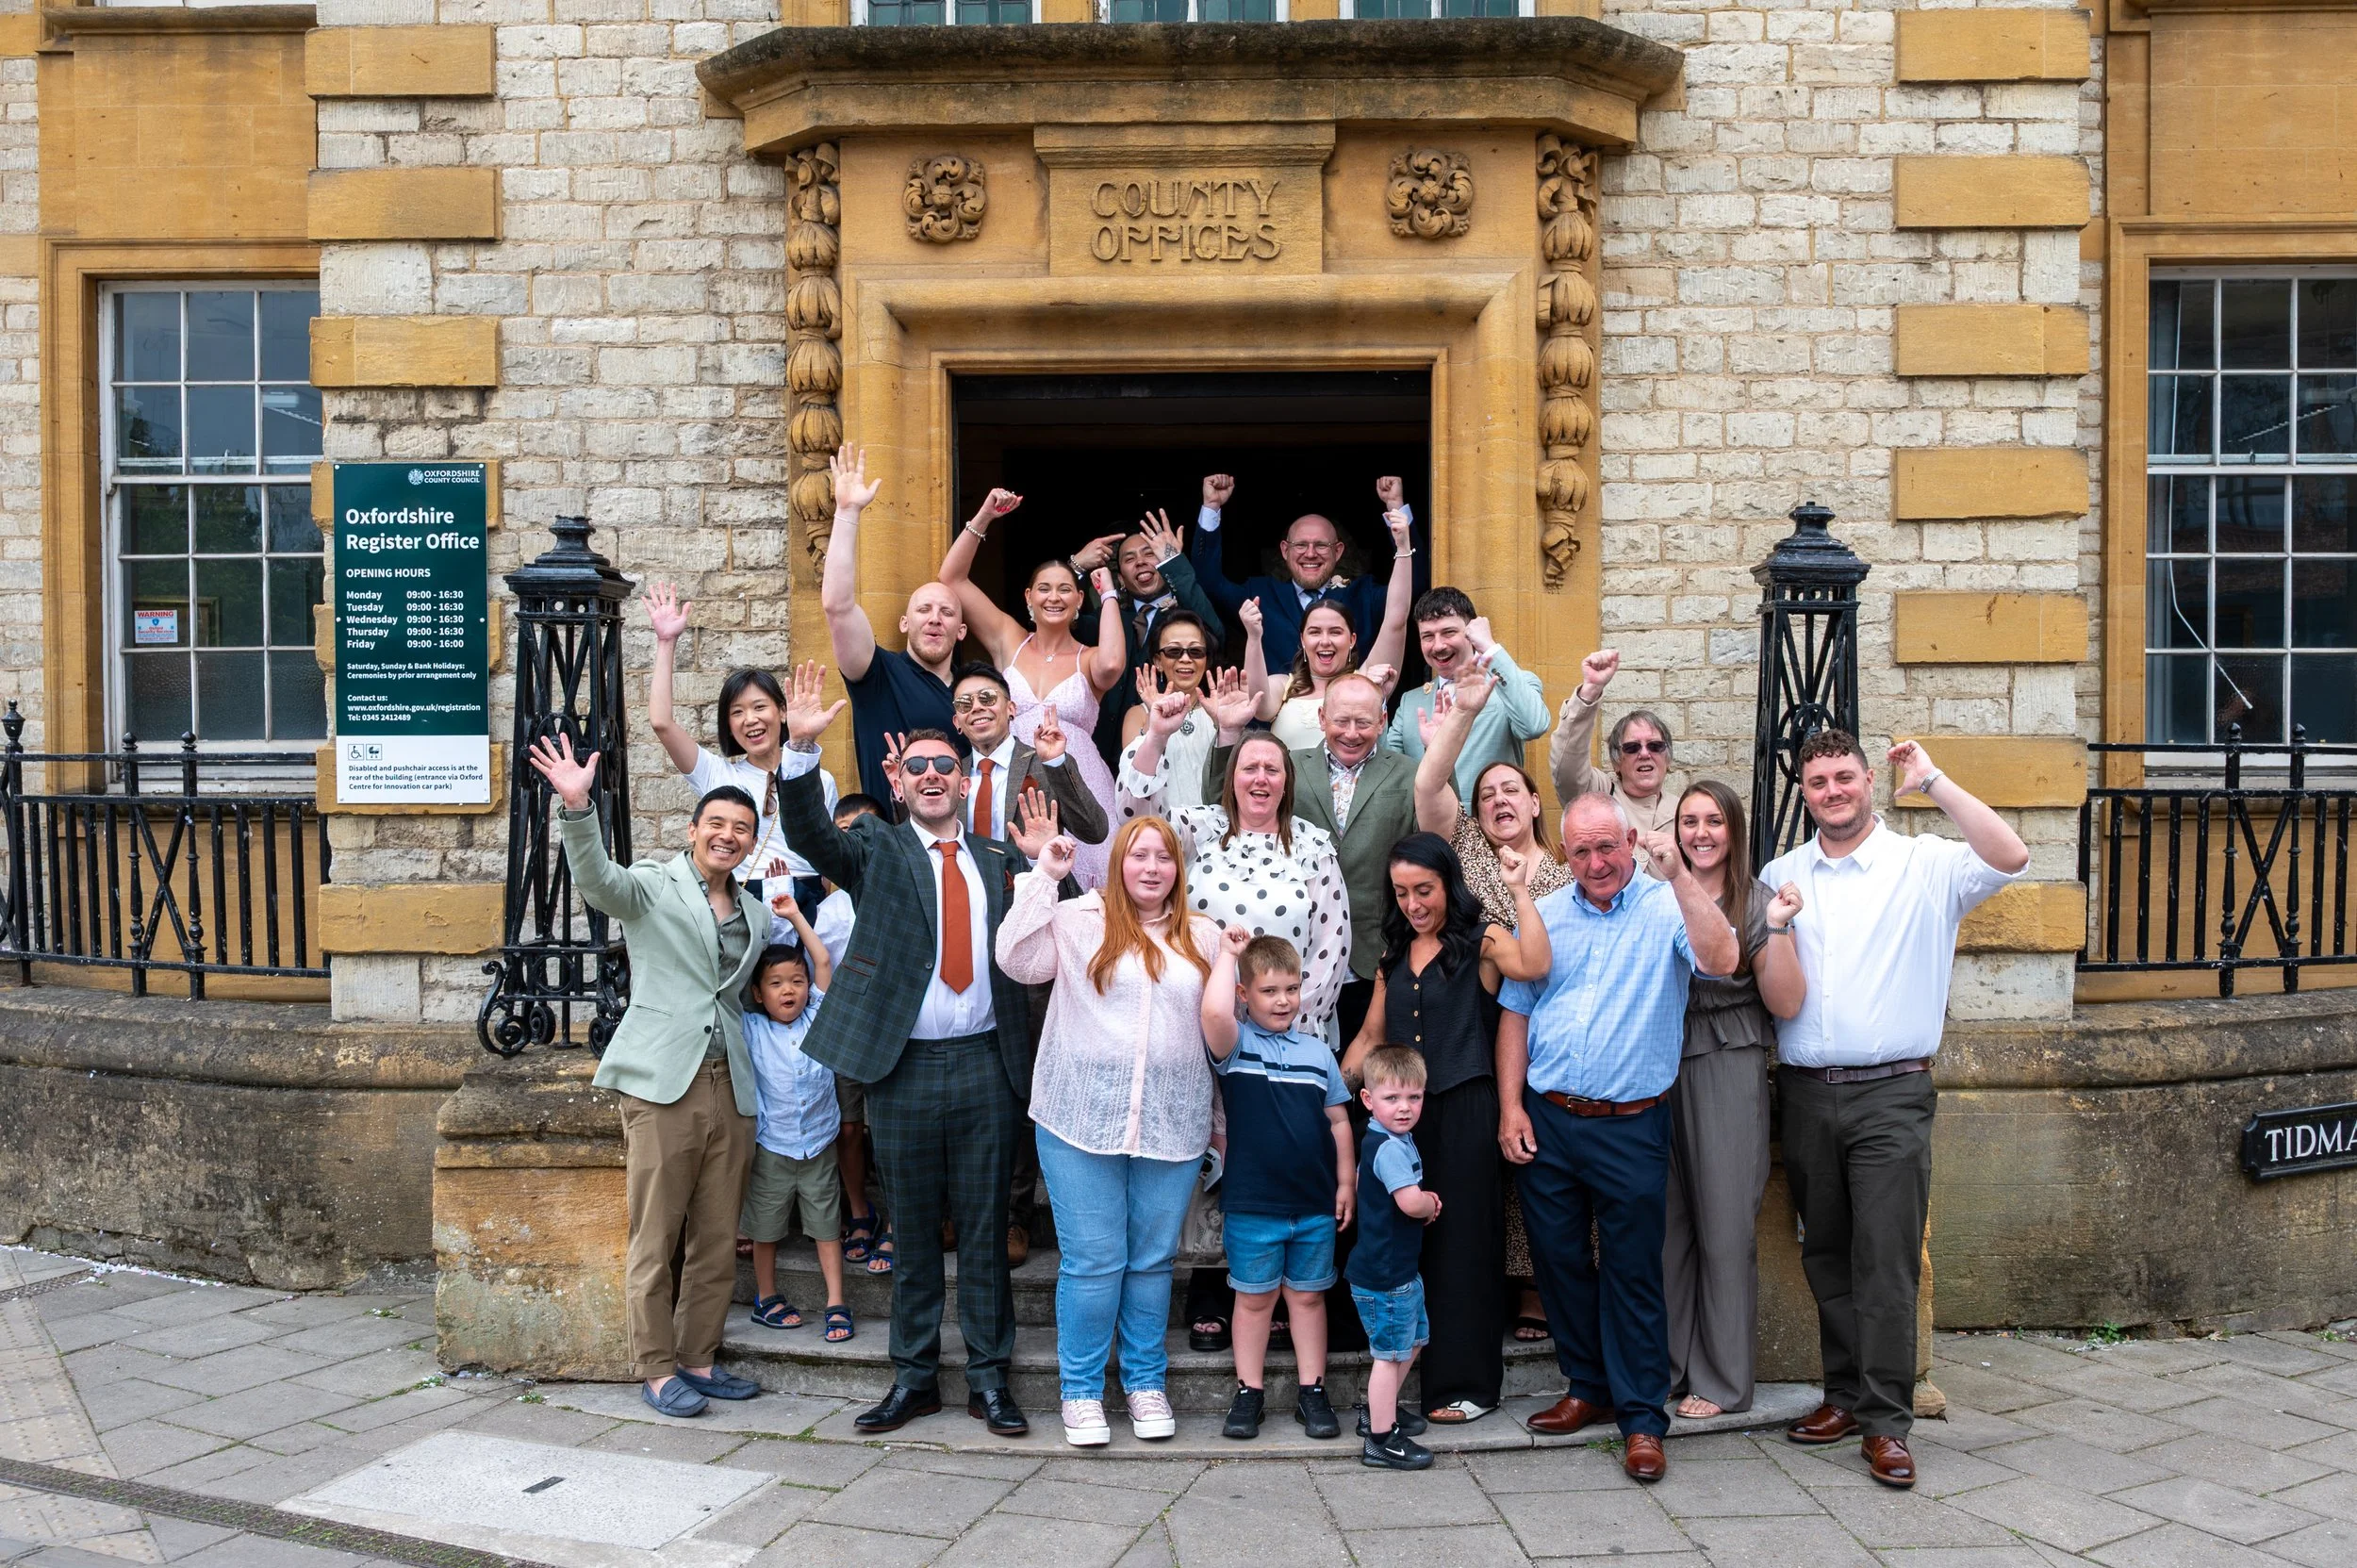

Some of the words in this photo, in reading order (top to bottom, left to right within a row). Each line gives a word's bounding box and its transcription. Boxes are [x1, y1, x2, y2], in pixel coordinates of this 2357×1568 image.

[1091, 179, 1280, 218] COUNTY
[1091, 223, 1281, 260] OFFICES
[346, 507, 453, 524] Oxfordshire
[347, 533, 421, 553] Register
[426, 532, 479, 549] Office
[346, 569, 392, 578] OPENING
[395, 569, 431, 577] HOURS
[347, 590, 382, 601] Monday
[406, 590, 431, 599] 09:00
[439, 590, 463, 599] 16:30
[346, 602, 384, 613] Tuesday
[439, 602, 464, 611] 16:30
[346, 615, 398, 625] Wednesday
[439, 615, 464, 623] 16:30
[347, 627, 388, 637] Thursday
[439, 627, 464, 635] 16:30
[347, 639, 375, 650] Friday
[439, 639, 464, 648] 16:00
[398, 671, 415, 680] prior
[348, 703, 480, 713] www.oxfordshire.gov.uk/registration
